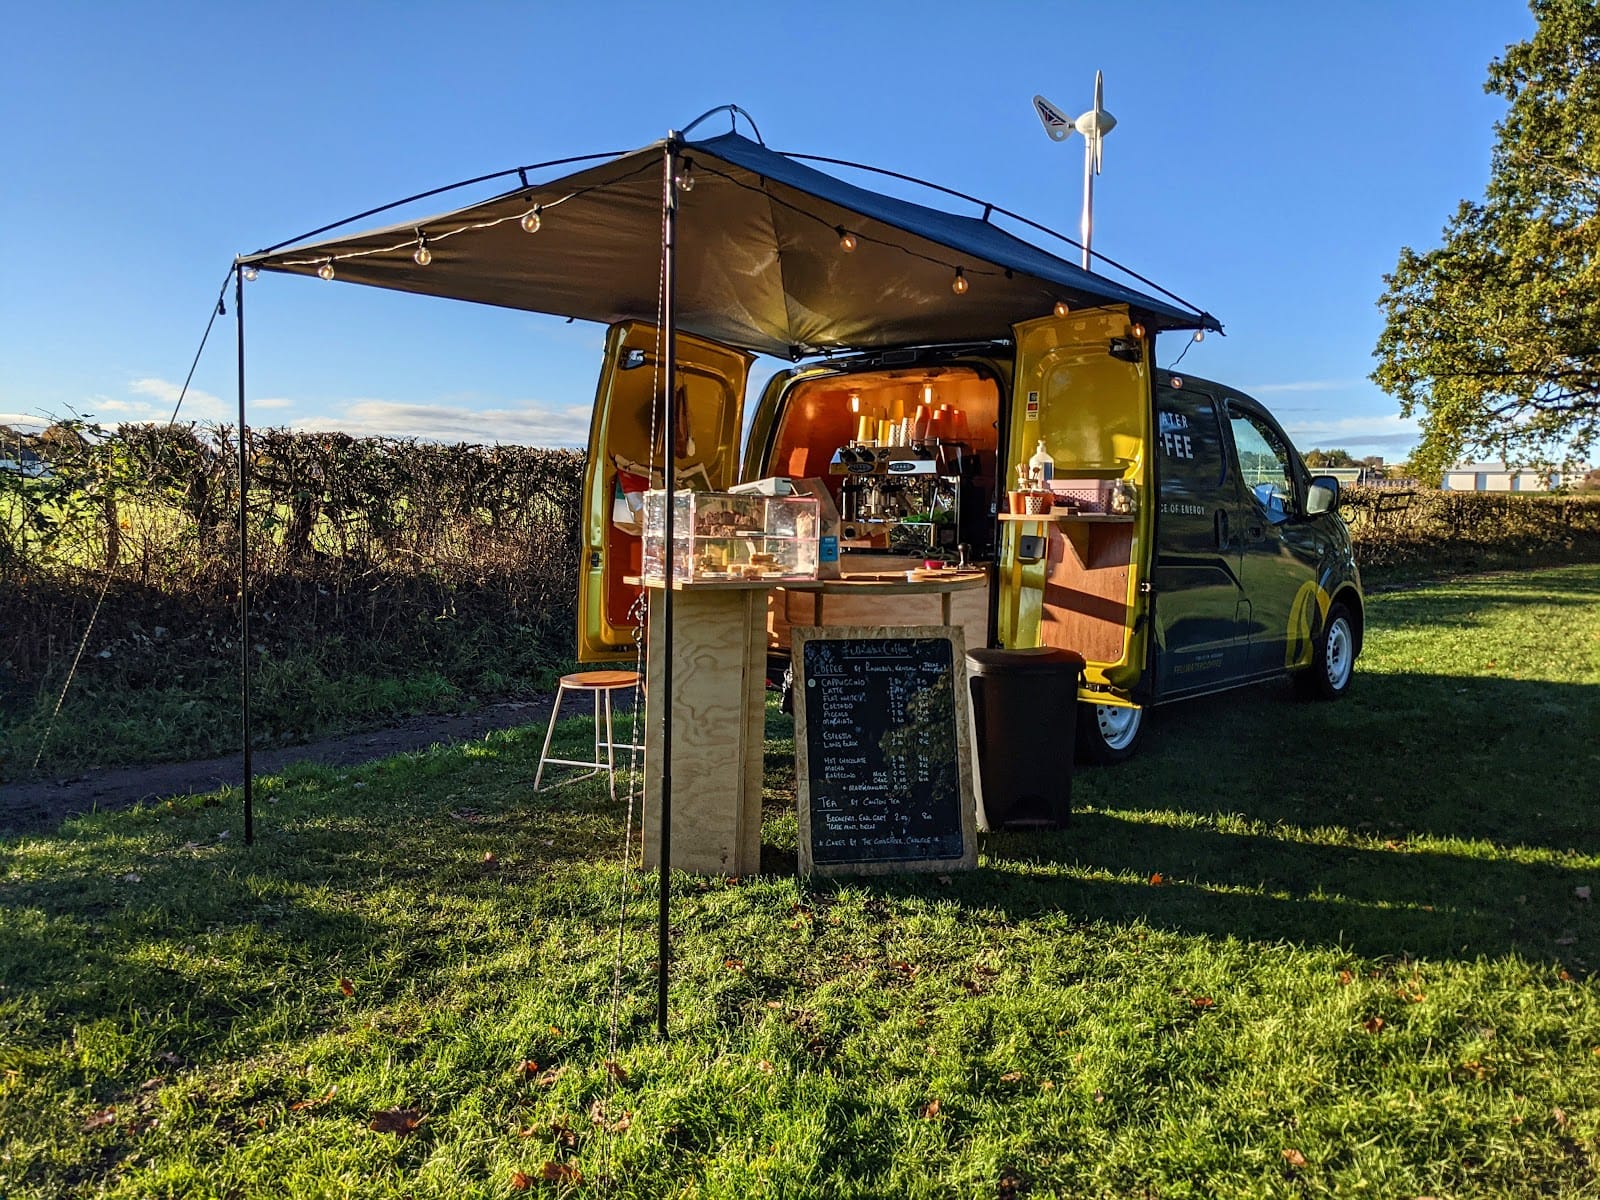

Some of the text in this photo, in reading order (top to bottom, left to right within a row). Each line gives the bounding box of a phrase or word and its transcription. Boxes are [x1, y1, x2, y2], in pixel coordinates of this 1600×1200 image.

[1170, 504, 1179, 513] OF
[1181, 504, 1205, 515] ENERGY
[821, 678, 866, 688] CAPPUCCINO
[822, 687, 843, 695] LATTE
[823, 702, 853, 711] CORTADO
[817, 796, 838, 808] TEA
[850, 798, 858, 806] BY
